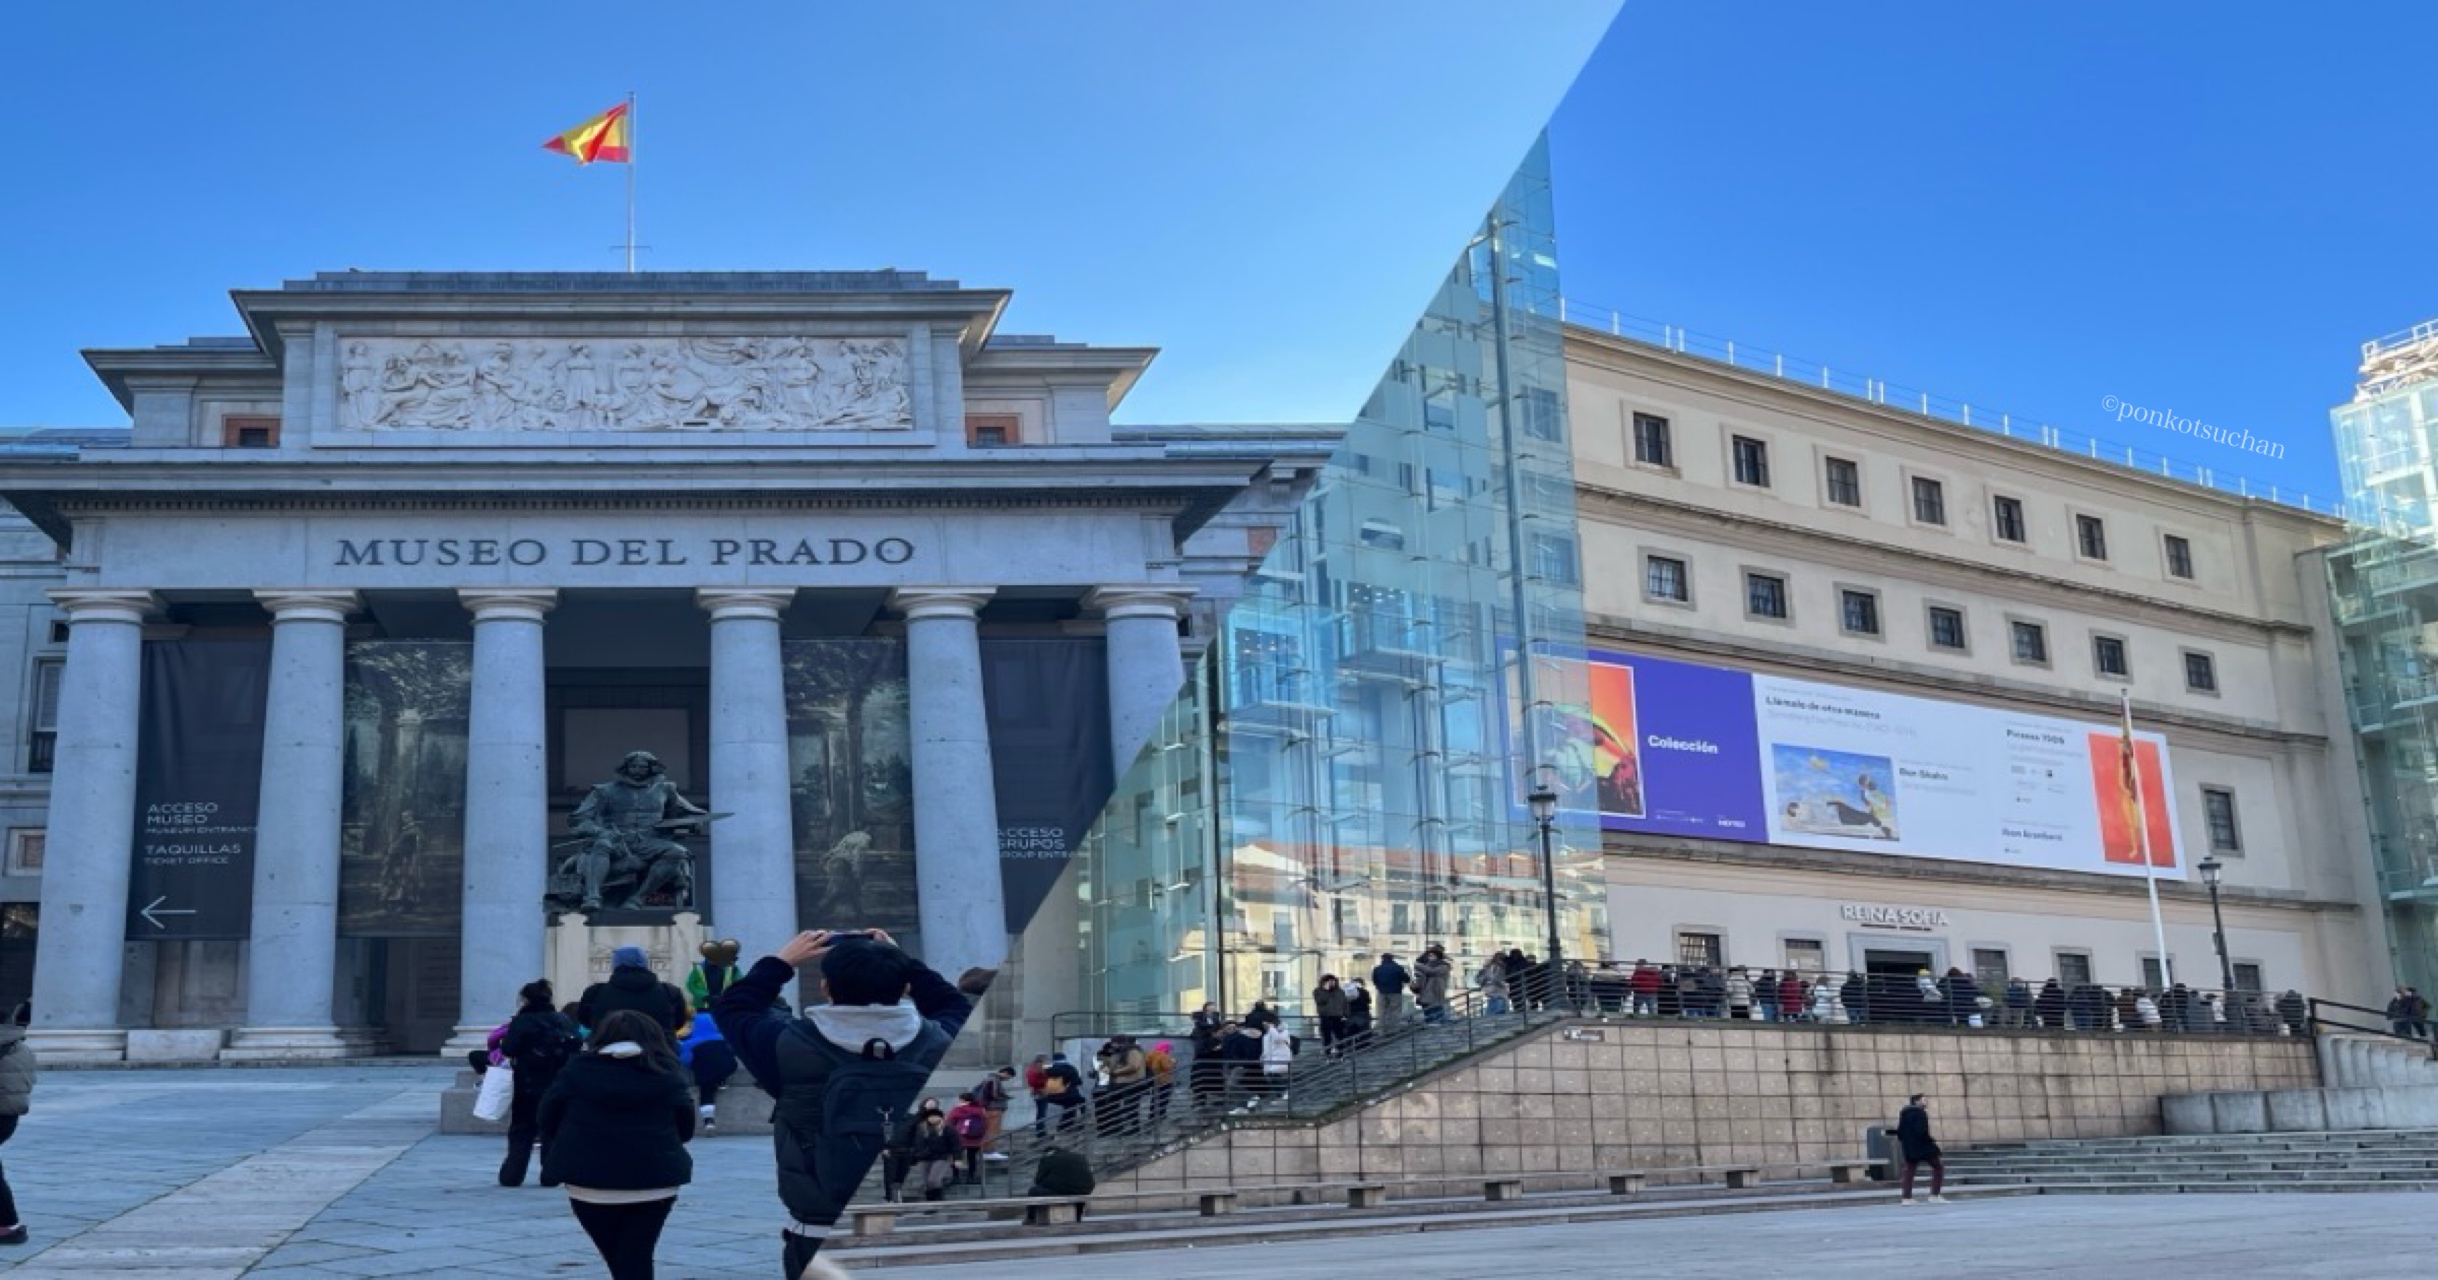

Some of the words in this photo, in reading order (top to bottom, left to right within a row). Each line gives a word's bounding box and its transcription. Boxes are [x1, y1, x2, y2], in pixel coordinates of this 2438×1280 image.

[333, 538, 547, 567] MUSEO
[571, 539, 688, 566] DEL
[710, 537, 915, 567] PRADO
[1647, 734, 1720, 755] Colección
[147, 802, 219, 814] ACCESO
[147, 814, 208, 826] MUSEO
[144, 844, 242, 855] TAQUILLAS
